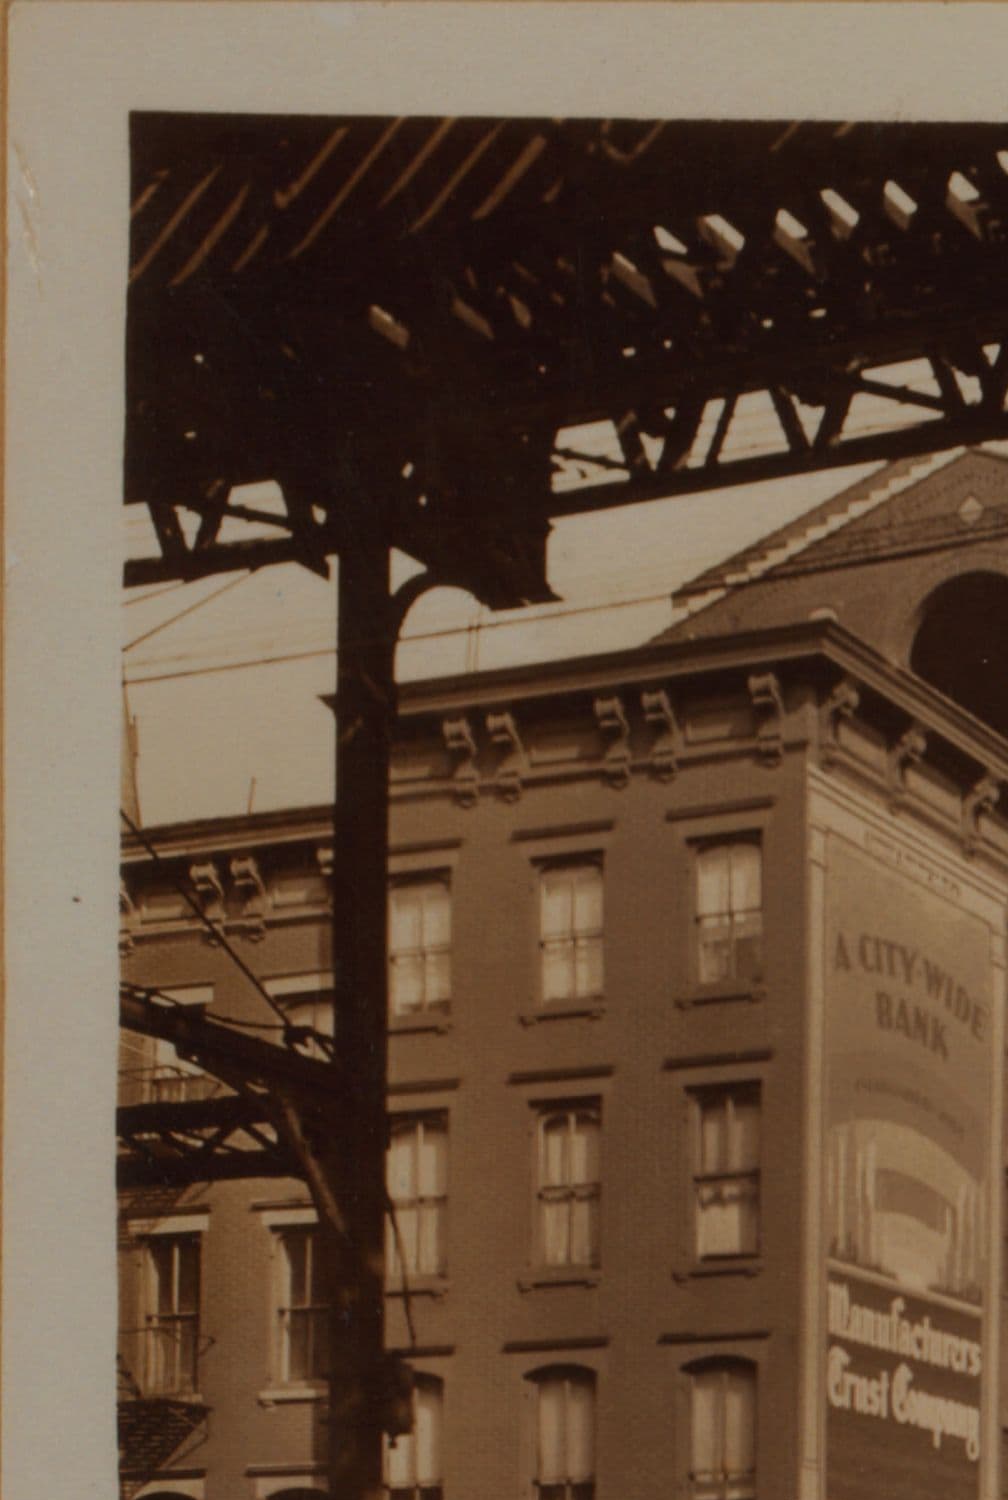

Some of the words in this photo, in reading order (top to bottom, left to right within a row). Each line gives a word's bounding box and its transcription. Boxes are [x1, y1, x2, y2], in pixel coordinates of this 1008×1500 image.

[834, 930, 852, 972] A
[858, 931, 989, 1043] CITY-WIDE
[875, 990, 950, 1062] BANK
[827, 1283, 983, 1377] Manufacturers
[891, 1361, 982, 1461] Company
